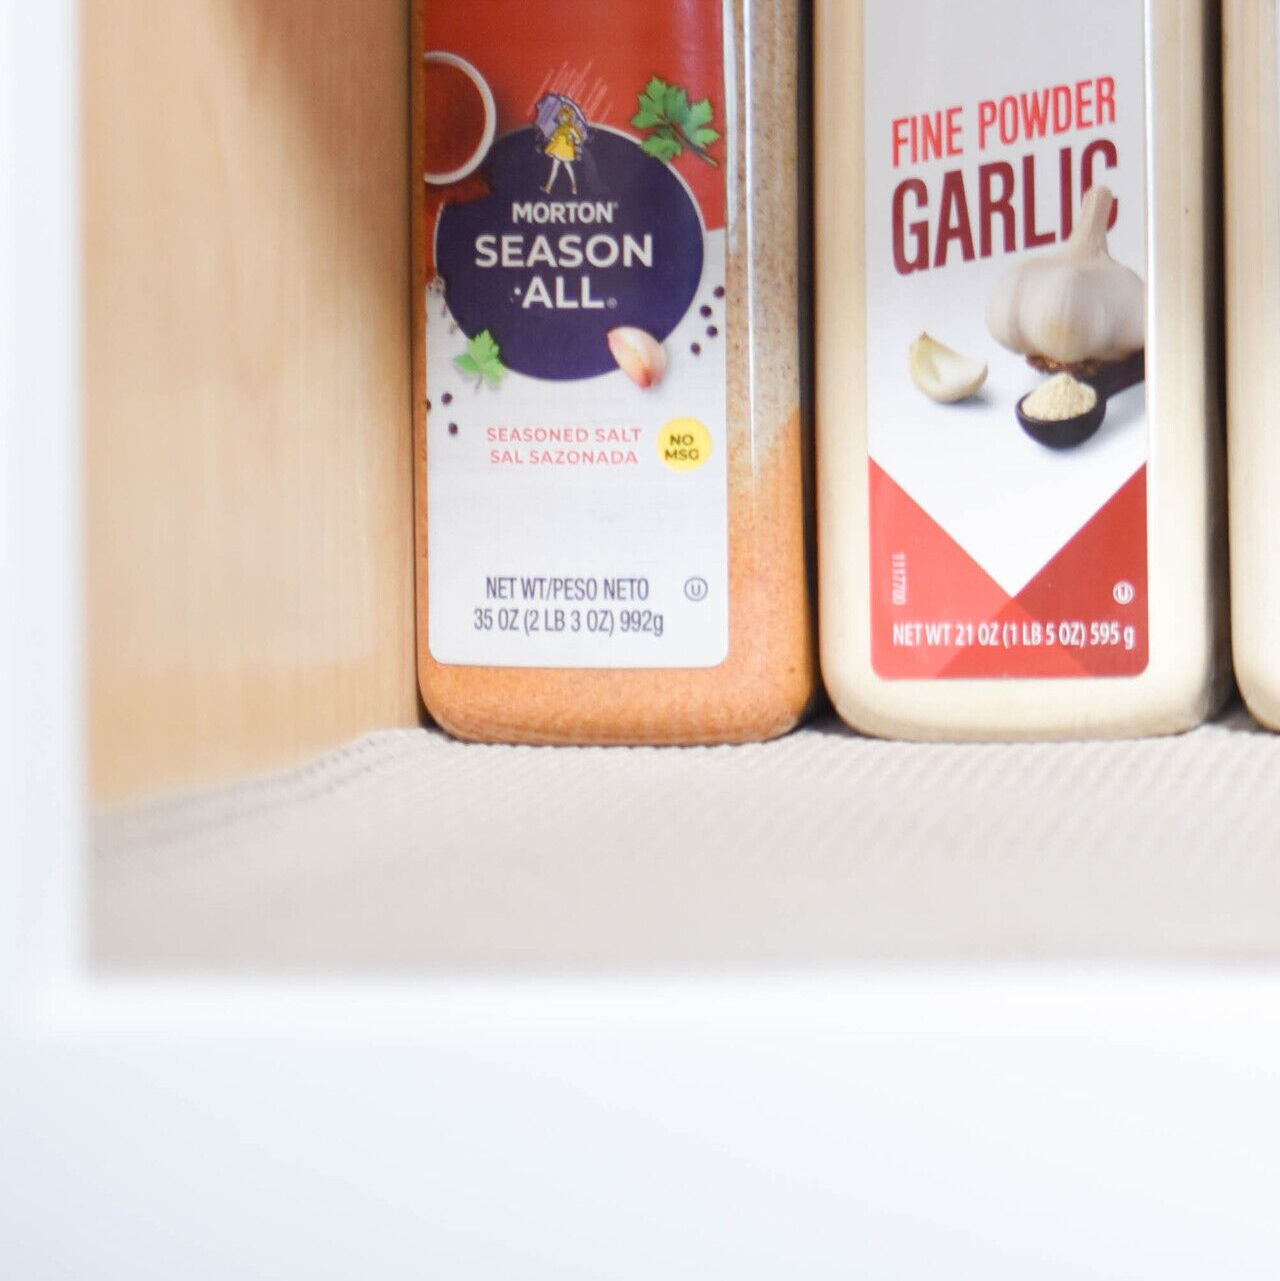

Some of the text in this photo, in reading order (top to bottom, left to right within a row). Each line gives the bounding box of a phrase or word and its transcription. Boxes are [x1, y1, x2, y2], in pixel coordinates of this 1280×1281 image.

[891, 75, 1117, 168] FINE POWDER
[891, 139, 1119, 275] GARLIC
[474, 234, 654, 268] SEASON
[486, 427, 643, 444] SEASONED SALT
[669, 433, 695, 447] NO
[490, 449, 639, 466] SAL SAZONADA
[664, 448, 701, 462] MSG
[485, 576, 650, 602] NET WT/PESO NETO
[473, 608, 665, 637] 35 OZ (2 LB 3 OZ) 992g
[892, 621, 1136, 650] NET WT 21 OZ (1 LB 5 OZ) 595 g
